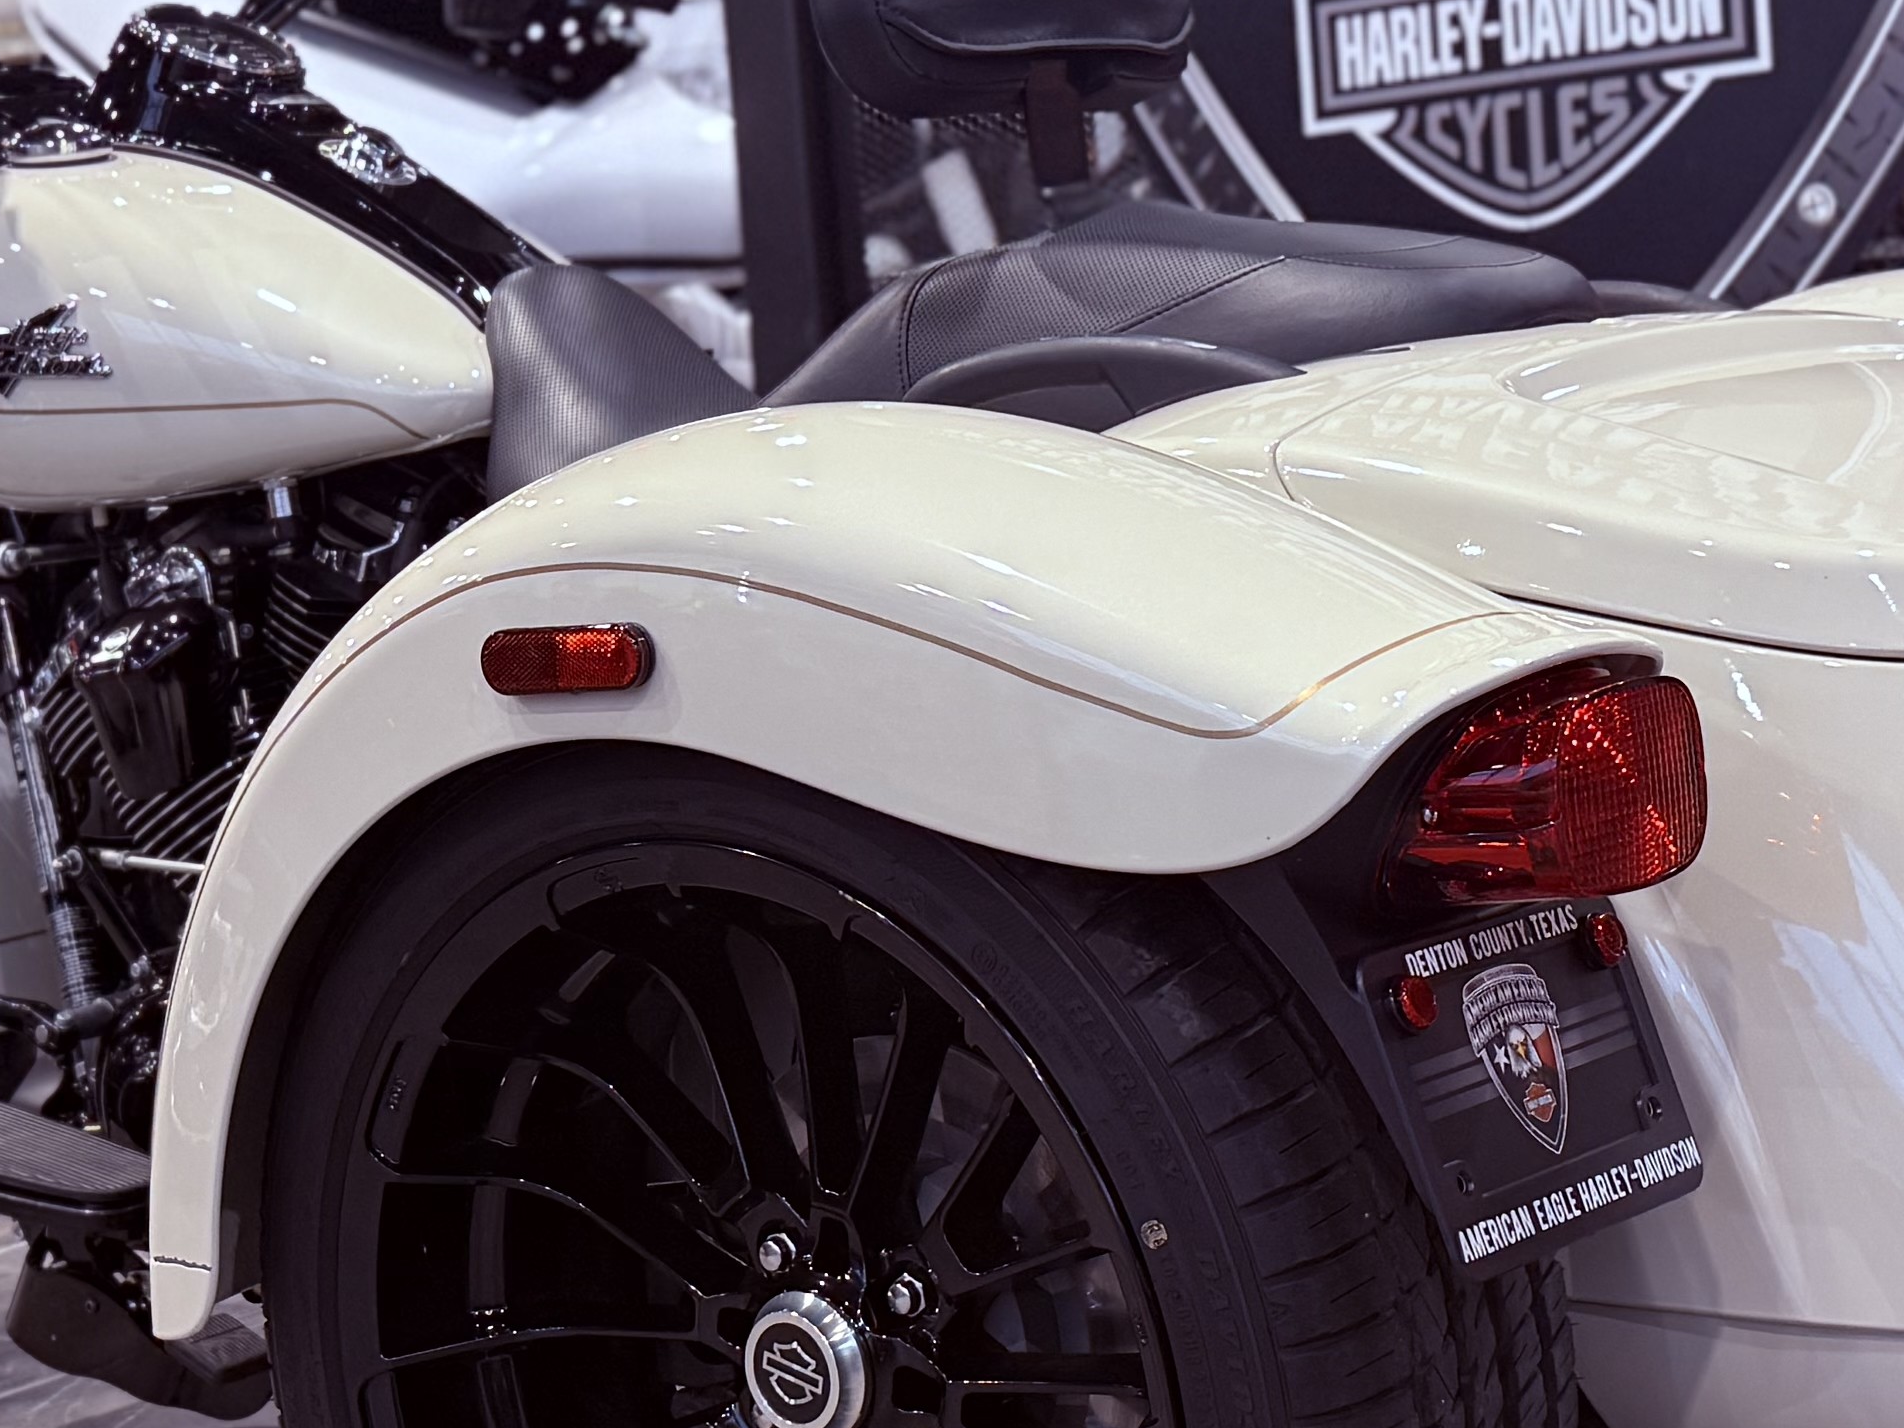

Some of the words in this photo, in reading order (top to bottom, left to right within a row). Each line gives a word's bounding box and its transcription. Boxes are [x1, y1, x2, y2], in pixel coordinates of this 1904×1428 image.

[1424, 74, 1634, 190] CYCLES
[1404, 937, 1470, 979] DENTON
[1457, 1204, 1536, 1265] AMERICAN
[1536, 1186, 1583, 1232] EAGLE
[1576, 1135, 1703, 1216] HARLEY-DAVIDSON
